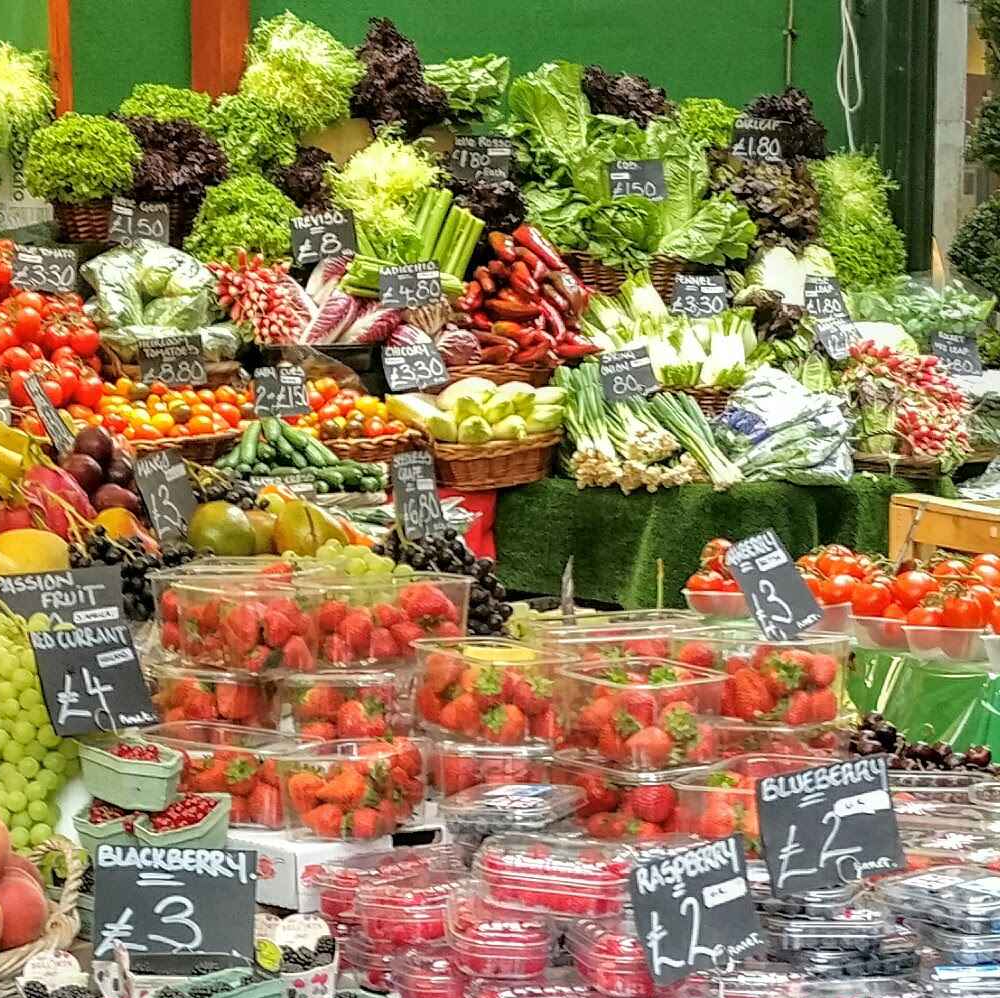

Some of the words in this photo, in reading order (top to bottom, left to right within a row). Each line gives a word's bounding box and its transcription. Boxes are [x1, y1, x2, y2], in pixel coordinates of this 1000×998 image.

[297, 232, 342, 262] £8
[761, 757, 890, 802] BLUEBERRY
[635, 837, 741, 896] RASPBERRY
[777, 810, 864, 889] £2
[93, 895, 203, 958] £3
[647, 897, 714, 977] £2
